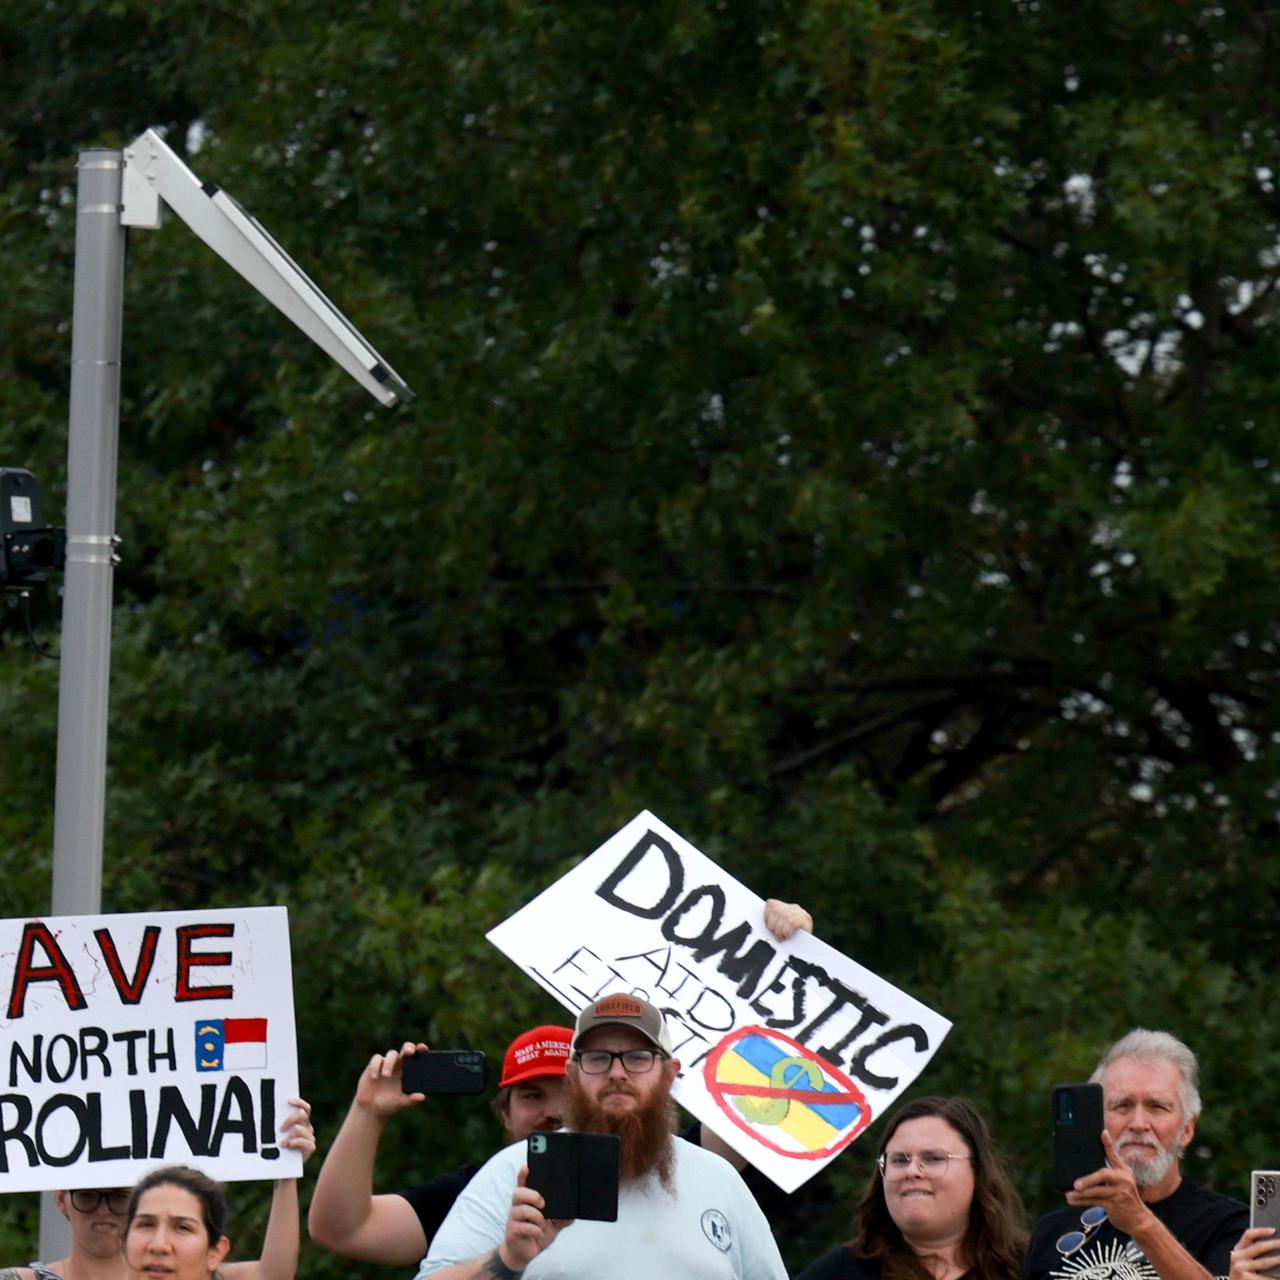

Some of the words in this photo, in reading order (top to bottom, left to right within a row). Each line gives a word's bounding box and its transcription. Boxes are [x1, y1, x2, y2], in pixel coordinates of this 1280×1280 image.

[595, 828, 929, 1090] DOMESTIC
[615, 944, 735, 1031] AID
[9, 1027, 177, 1087] NORTH
